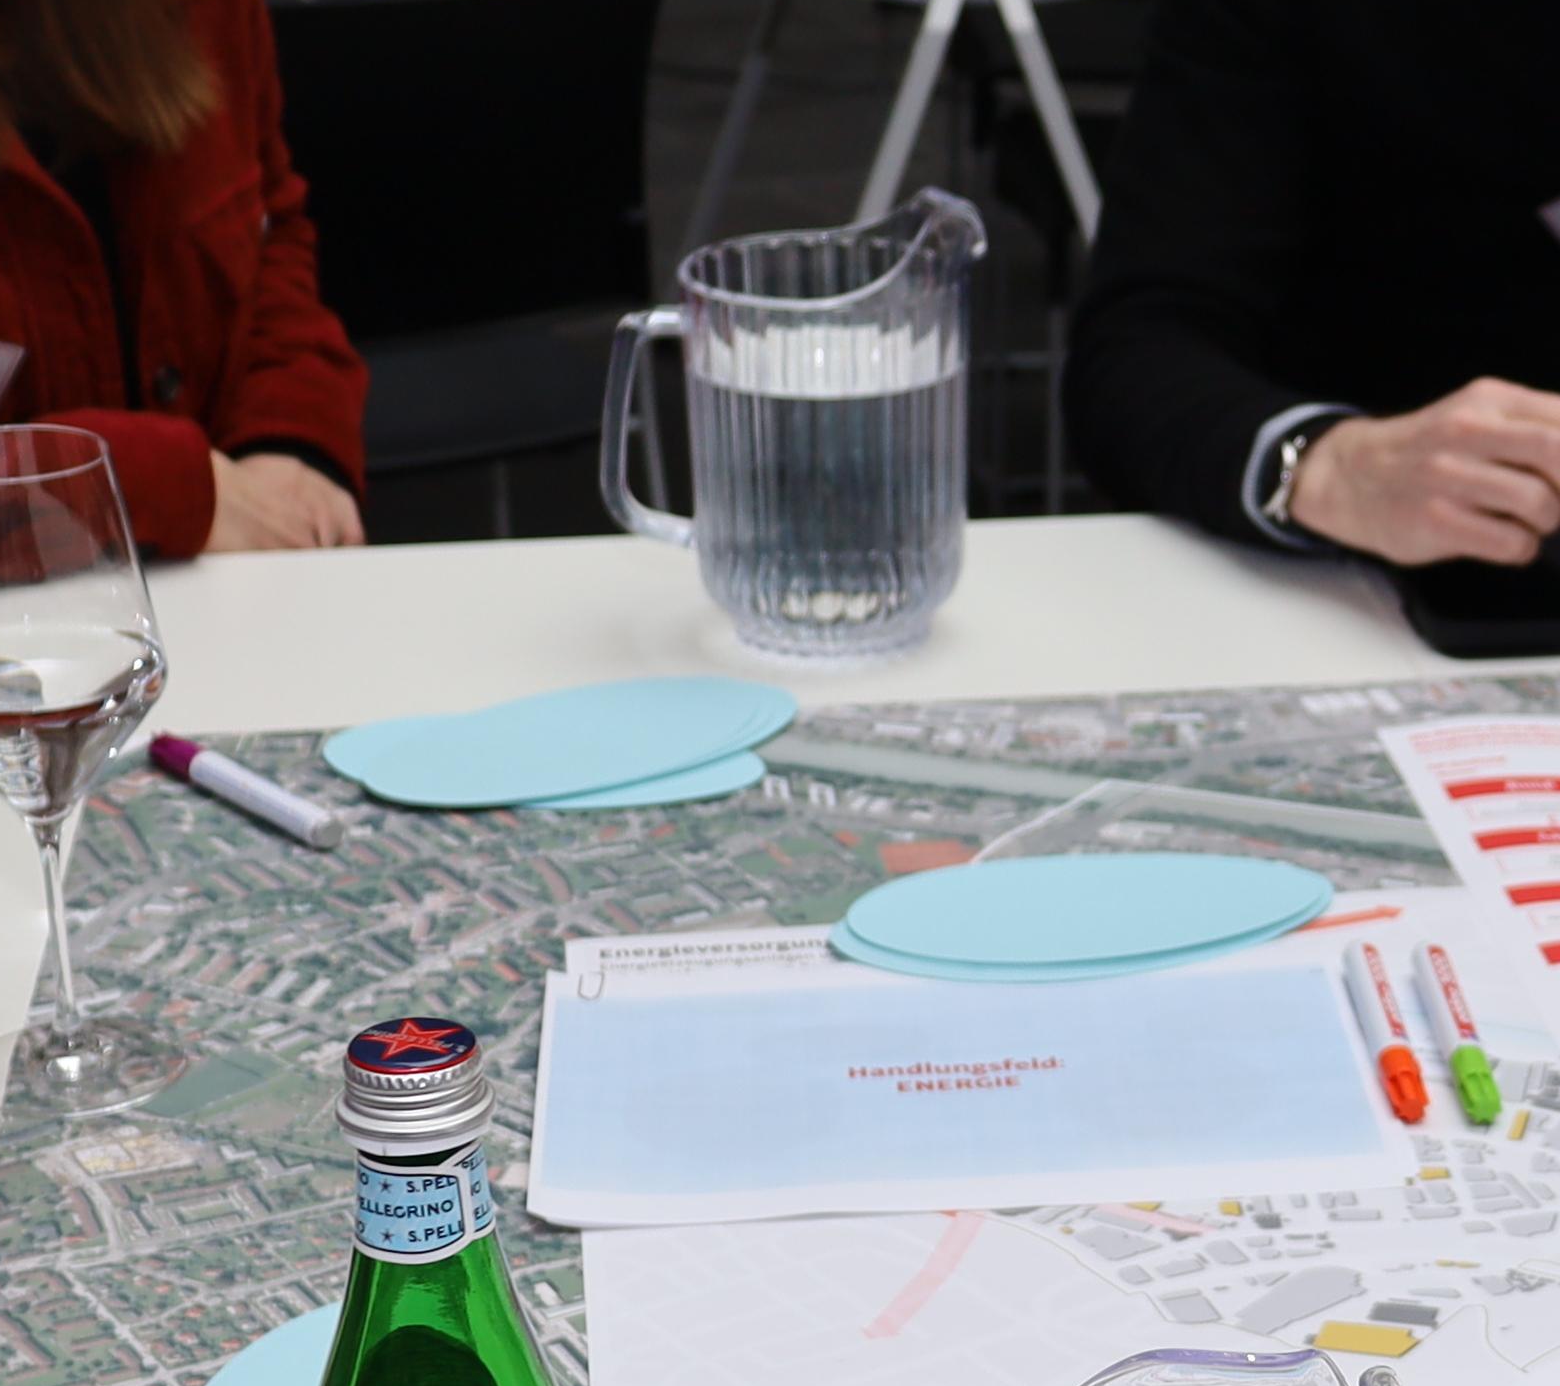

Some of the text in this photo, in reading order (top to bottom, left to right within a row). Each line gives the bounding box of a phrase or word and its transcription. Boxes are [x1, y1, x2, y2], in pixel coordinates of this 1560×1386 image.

[848, 1055, 1067, 1083] Handlungsfeld:
[896, 1074, 1022, 1094] ENERGIE
[358, 1196, 454, 1219] ELLEGRINO
